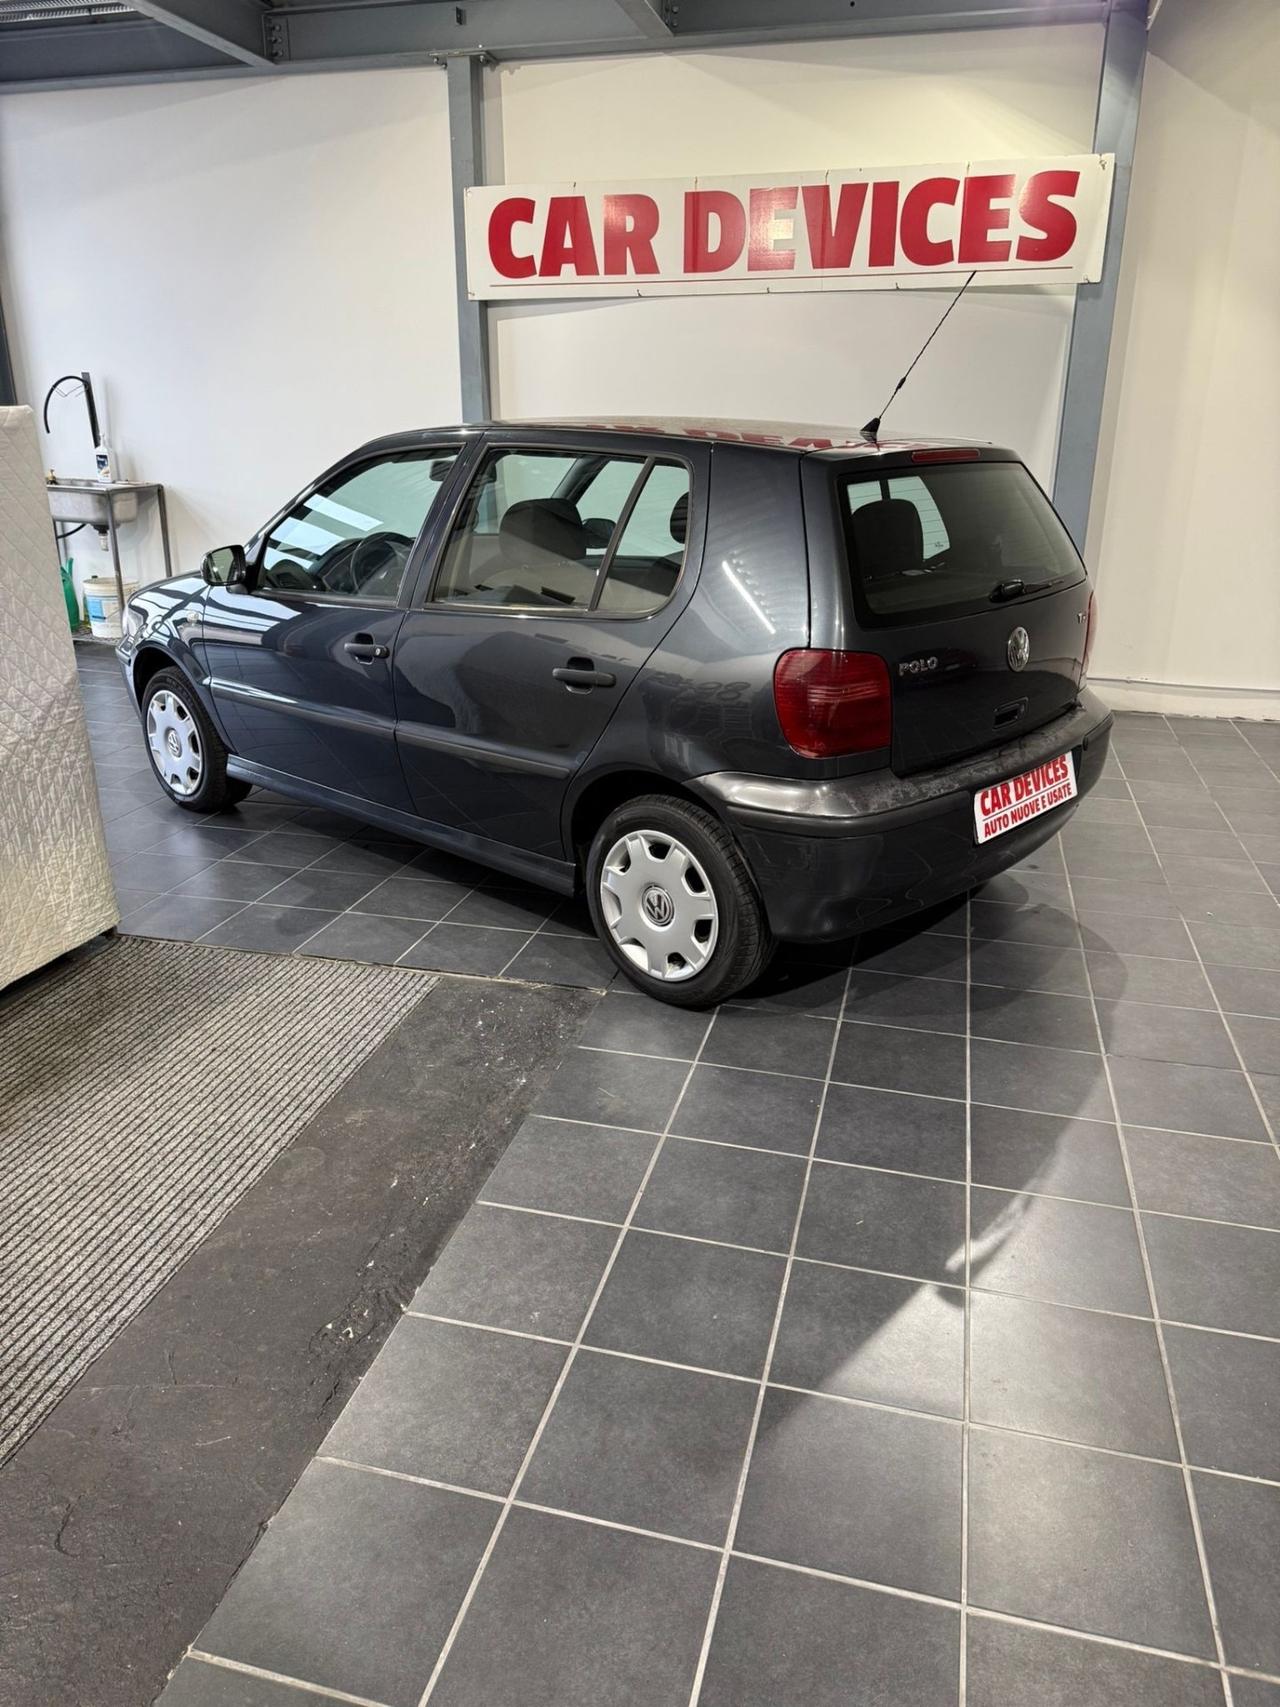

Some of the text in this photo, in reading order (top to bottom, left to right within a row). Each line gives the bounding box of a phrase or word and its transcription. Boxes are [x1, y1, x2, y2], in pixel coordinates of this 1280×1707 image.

[488, 170, 1080, 278] CAR DEVICES
[899, 656, 938, 676] POLO
[980, 755, 1069, 816] CAR DEVICES
[984, 814, 1009, 838] AUTO
[1010, 798, 1041, 825] NUOVE
[1041, 795, 1048, 809] E
